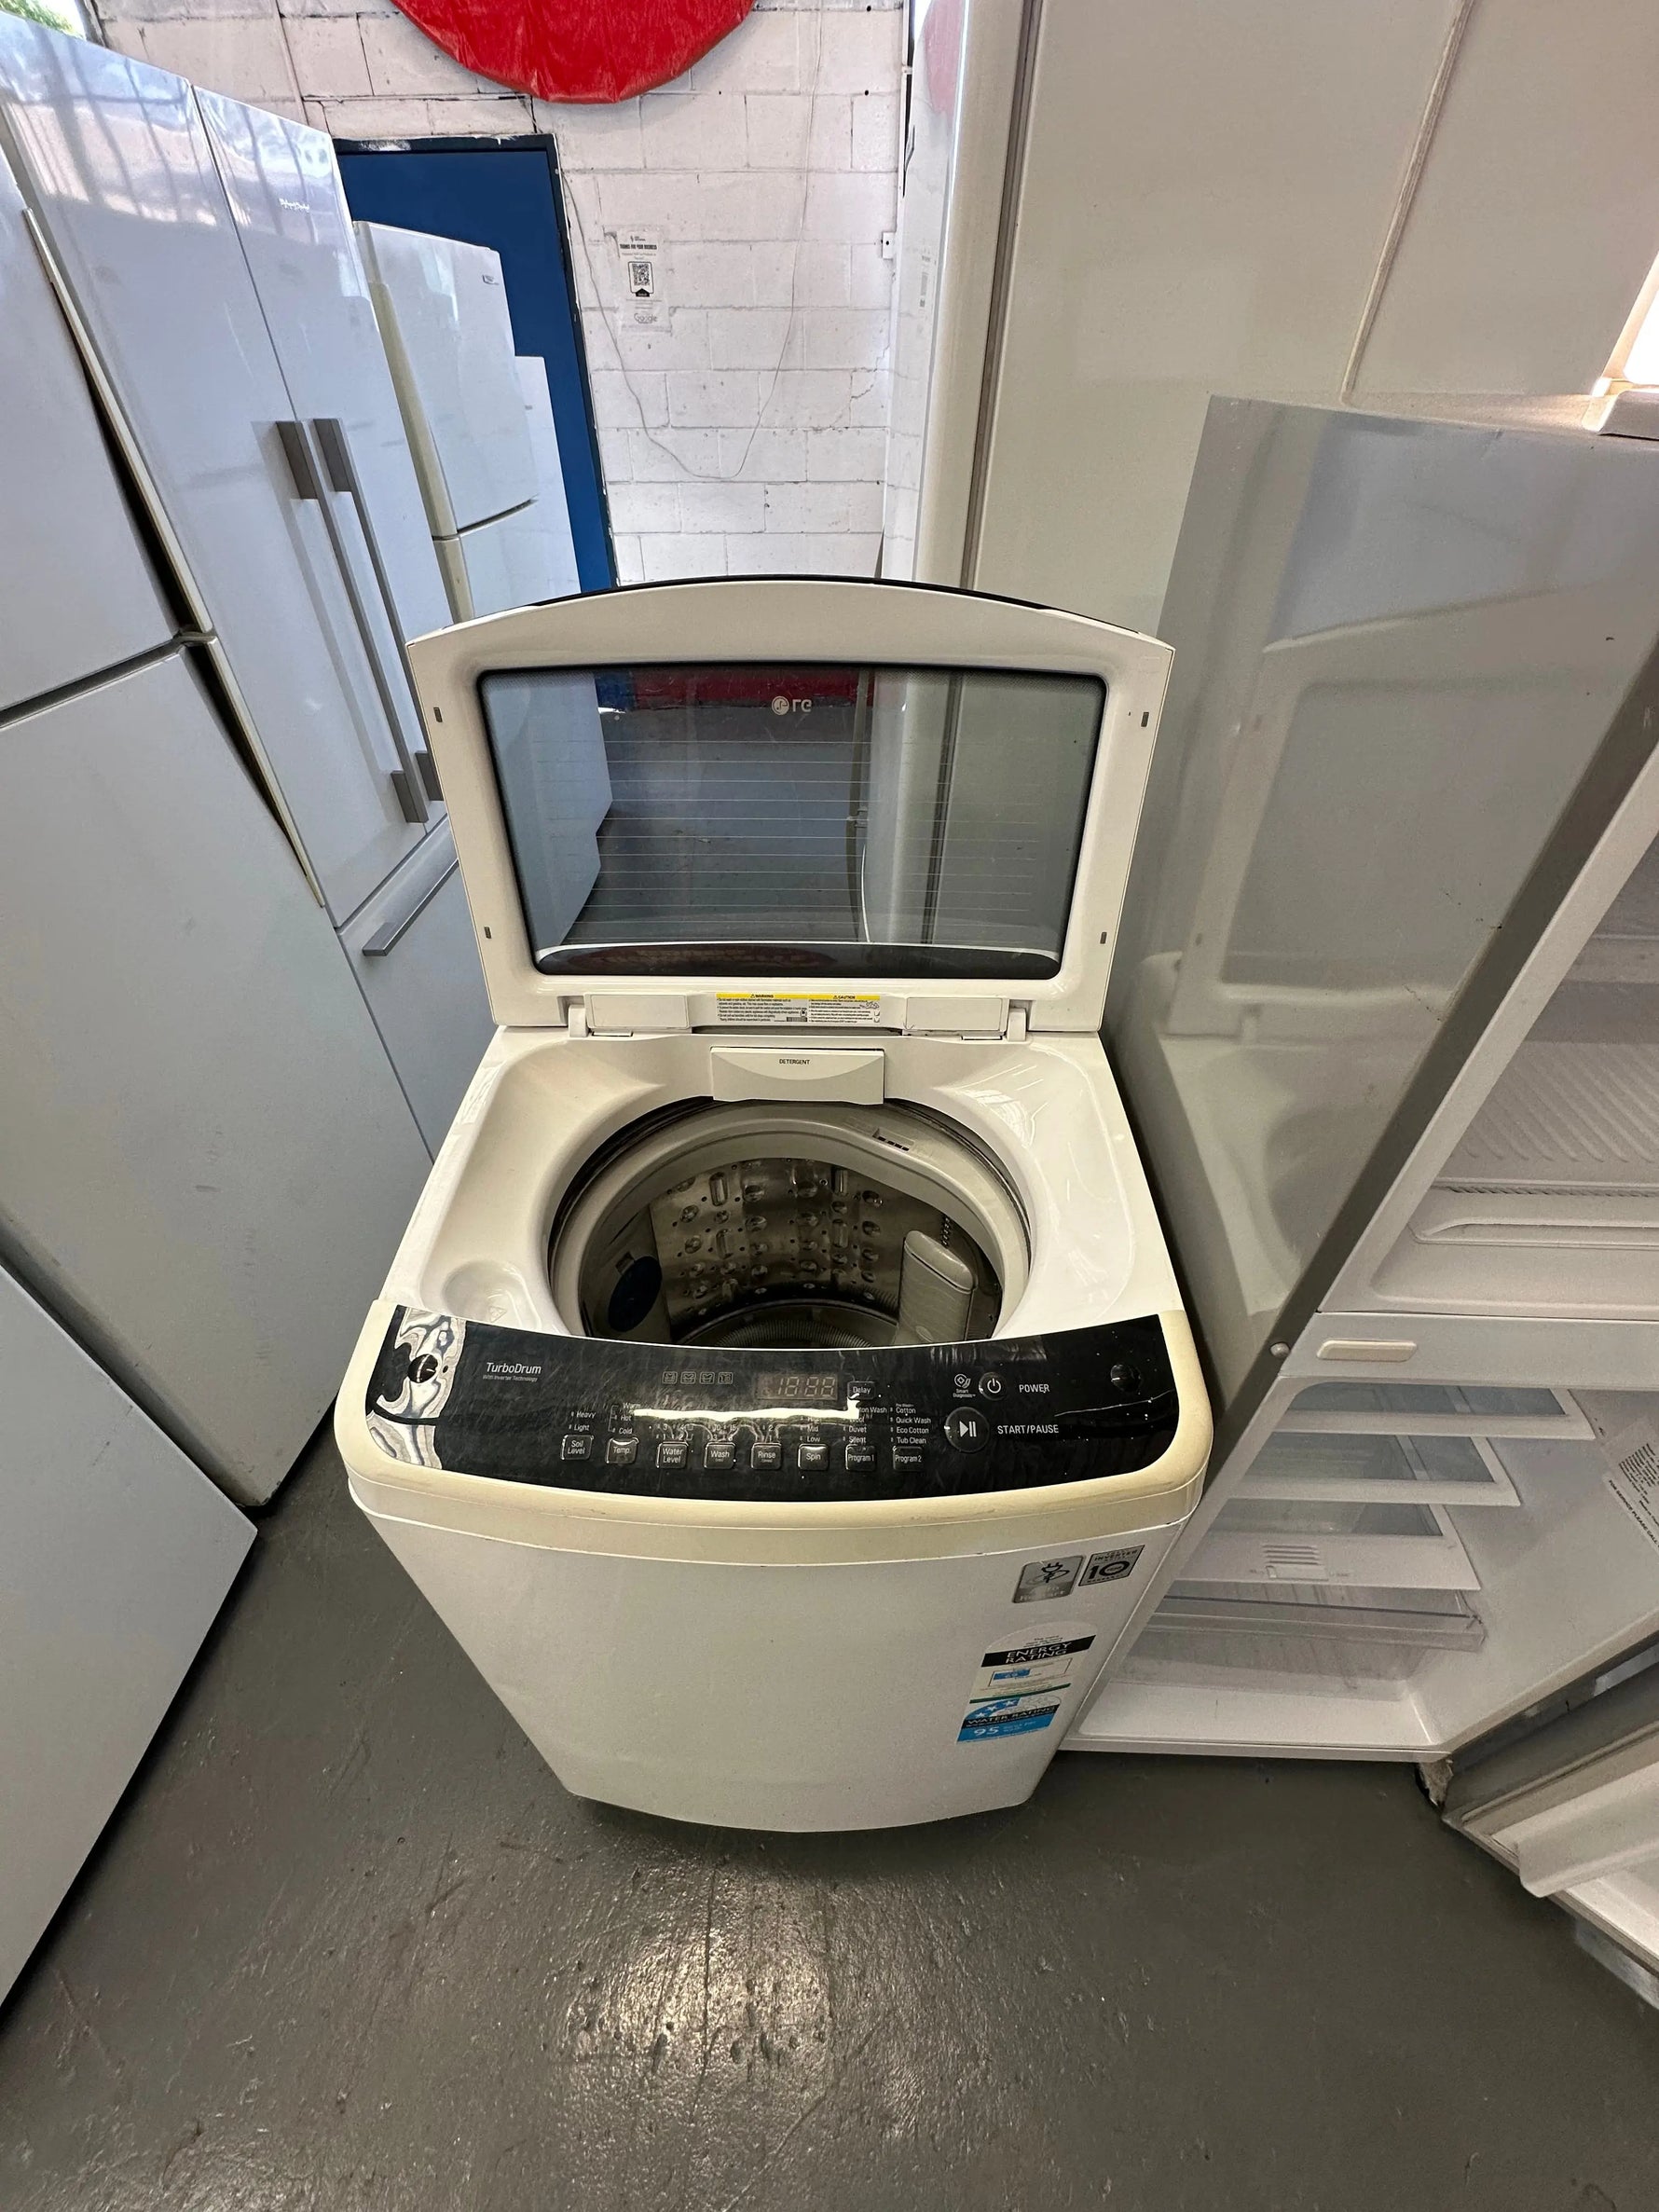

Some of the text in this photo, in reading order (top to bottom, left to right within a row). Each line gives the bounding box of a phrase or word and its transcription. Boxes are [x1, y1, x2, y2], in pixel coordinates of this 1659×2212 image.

[634, 313, 657, 324] Google
[487, 1362, 542, 1374] TurboDrum
[852, 1386, 871, 1395] Delay
[1019, 1383, 1049, 1393] POWER
[997, 1424, 1059, 1435] START/PAUSE
[613, 1447, 632, 1455] Temp.
[758, 1450, 775, 1459] Rinse
[848, 1454, 871, 1463] Program
[895, 1454, 917, 1463] Program
[1089, 1560, 1131, 1579] 10
[1007, 1642, 1072, 1658] ENERGY
[1006, 1650, 1067, 1664] RATING
[967, 1707, 1055, 1724] WATER RATING
[973, 1726, 999, 1736] 95
